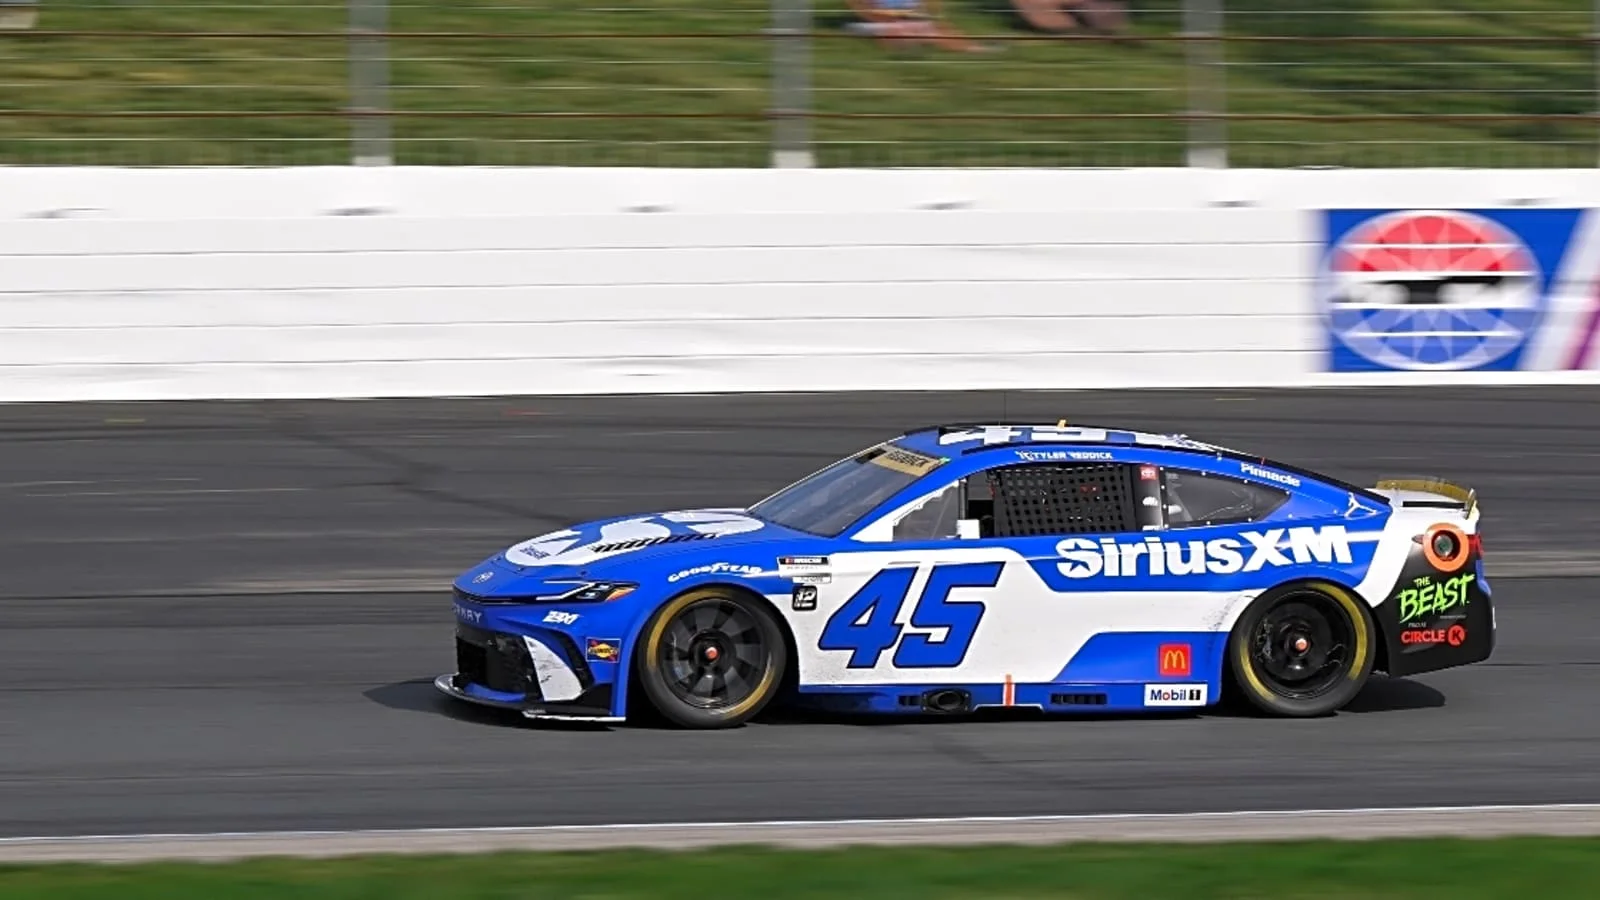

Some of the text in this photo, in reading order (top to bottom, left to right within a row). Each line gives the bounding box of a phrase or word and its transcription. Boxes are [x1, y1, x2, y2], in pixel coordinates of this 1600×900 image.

[1032, 451, 1067, 460] TYLER
[1240, 461, 1301, 487] Pinnacle
[1055, 525, 1353, 579] SiriusXM
[1413, 576, 1431, 588] THE
[1396, 572, 1476, 624] BEAST
[817, 561, 1007, 669] 45
[1401, 629, 1446, 644] CIRCLE
[1150, 689, 1202, 701] Mobil 1
